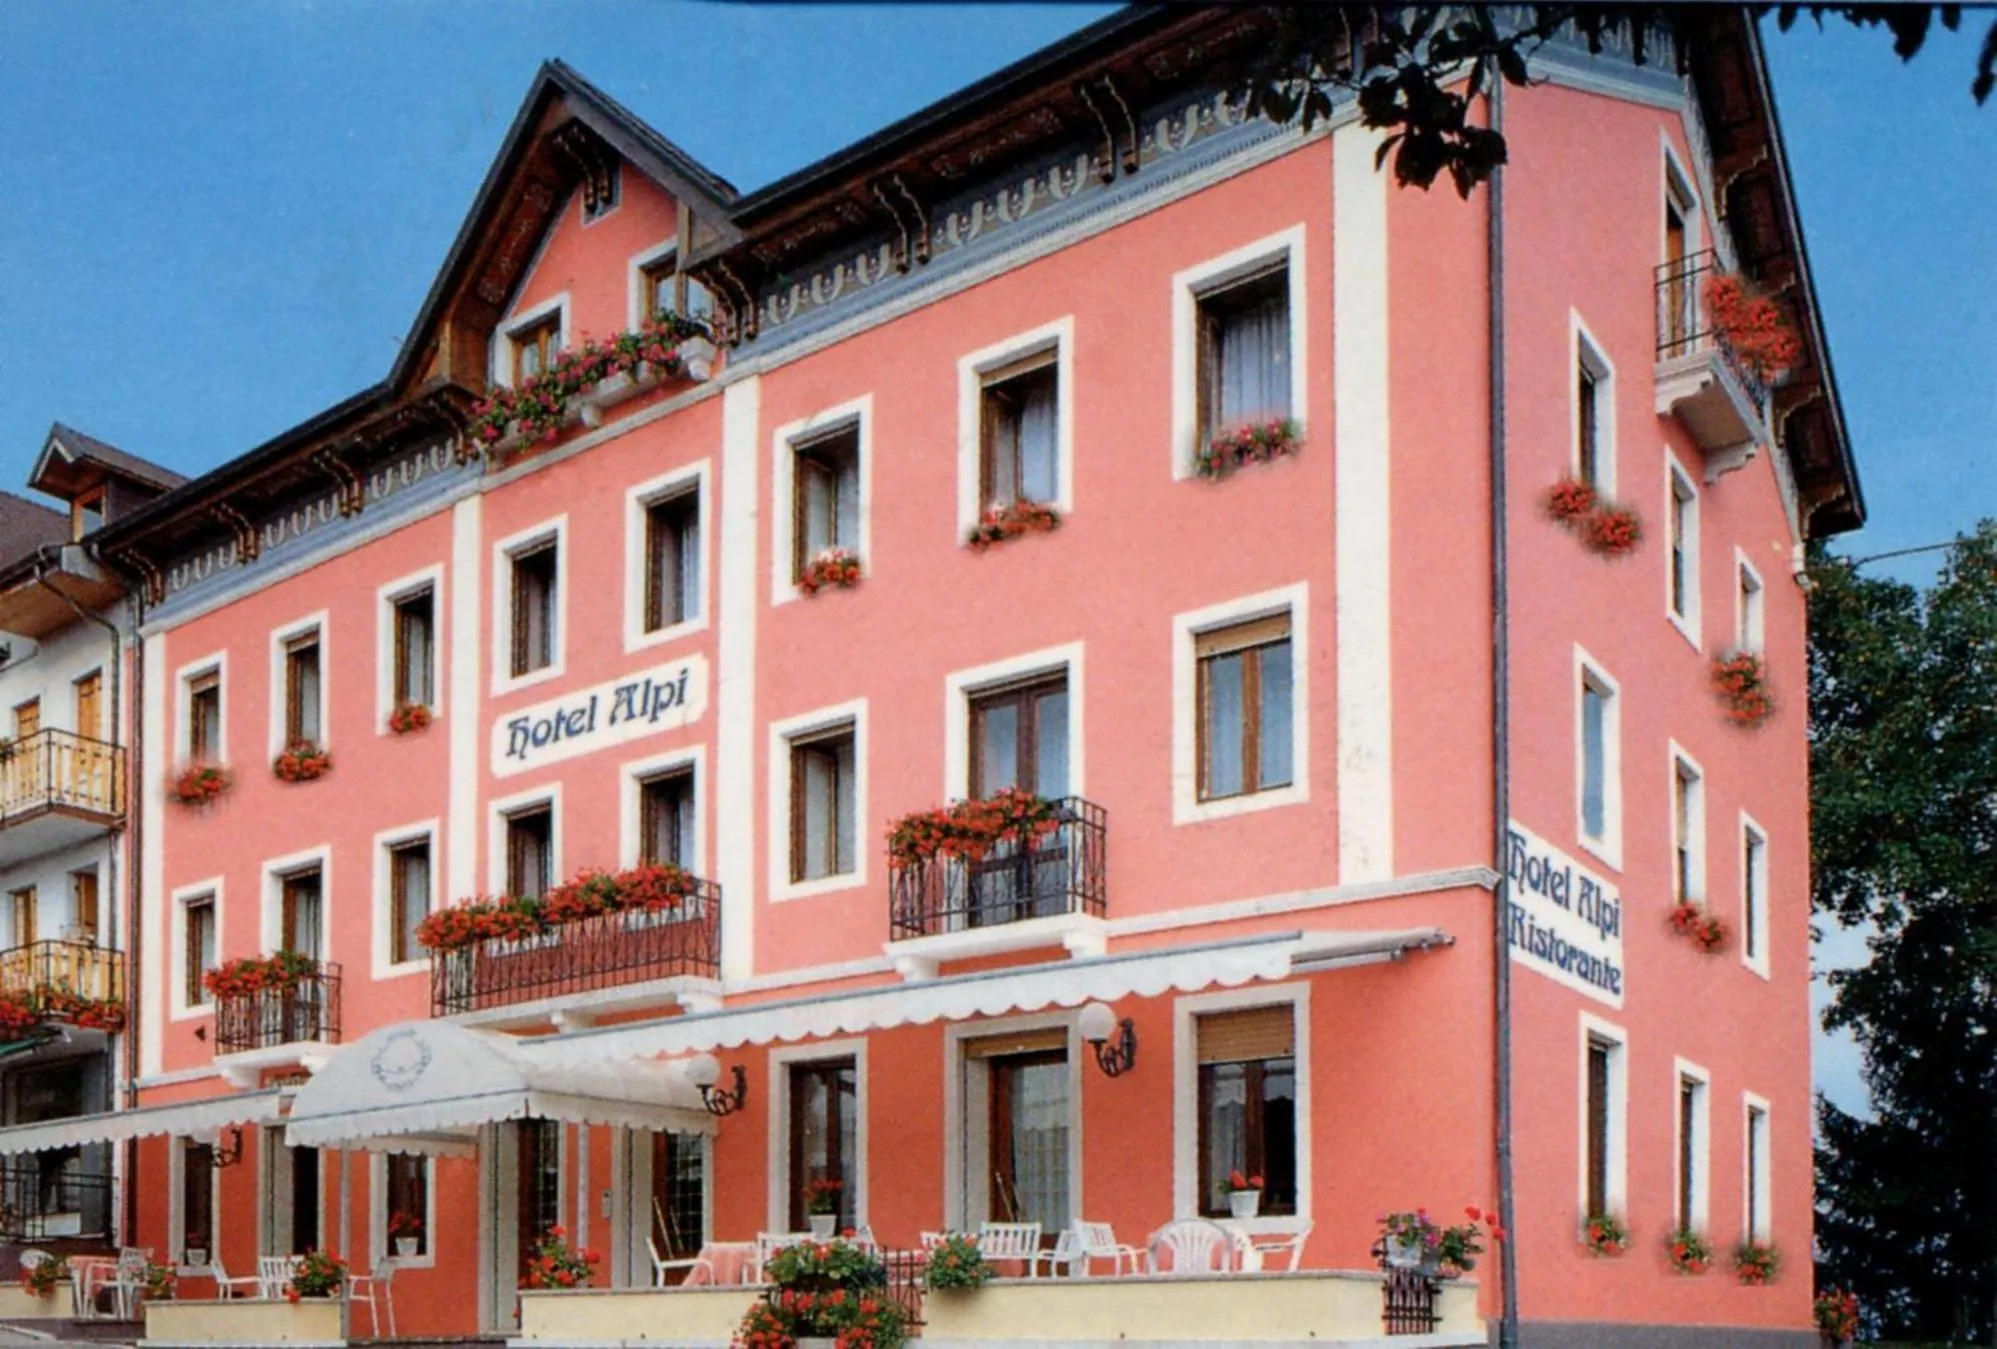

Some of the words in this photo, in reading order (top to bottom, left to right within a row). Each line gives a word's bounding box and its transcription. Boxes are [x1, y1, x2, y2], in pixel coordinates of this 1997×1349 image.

[608, 668, 689, 725] Alpi
[1577, 875, 1620, 941] Alpi
[1507, 902, 1621, 996] Ristorante
